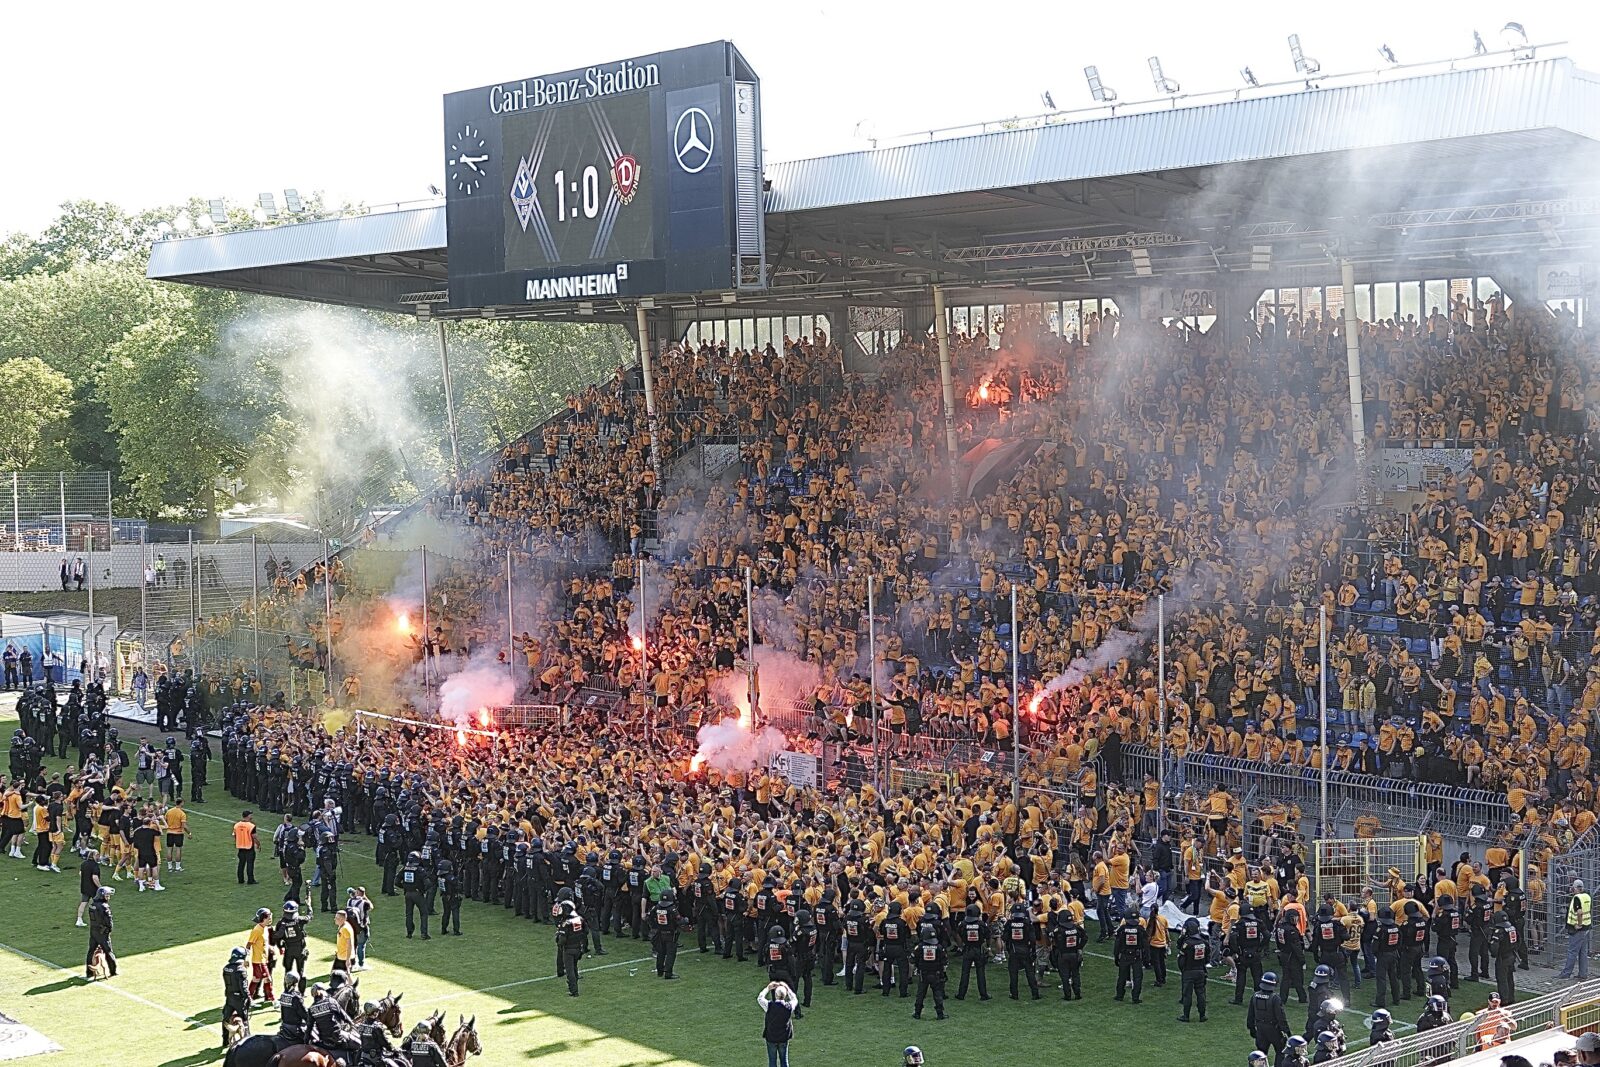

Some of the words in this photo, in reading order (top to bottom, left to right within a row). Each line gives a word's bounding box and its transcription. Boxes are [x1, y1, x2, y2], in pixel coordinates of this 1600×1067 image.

[489, 60, 660, 114] Carl-Benz-Stadion
[554, 165, 599, 222] 1:0
[612, 181, 639, 206] DRESDEN
[526, 273, 618, 300] MANNHEIM
[1469, 826, 1483, 836] 23
